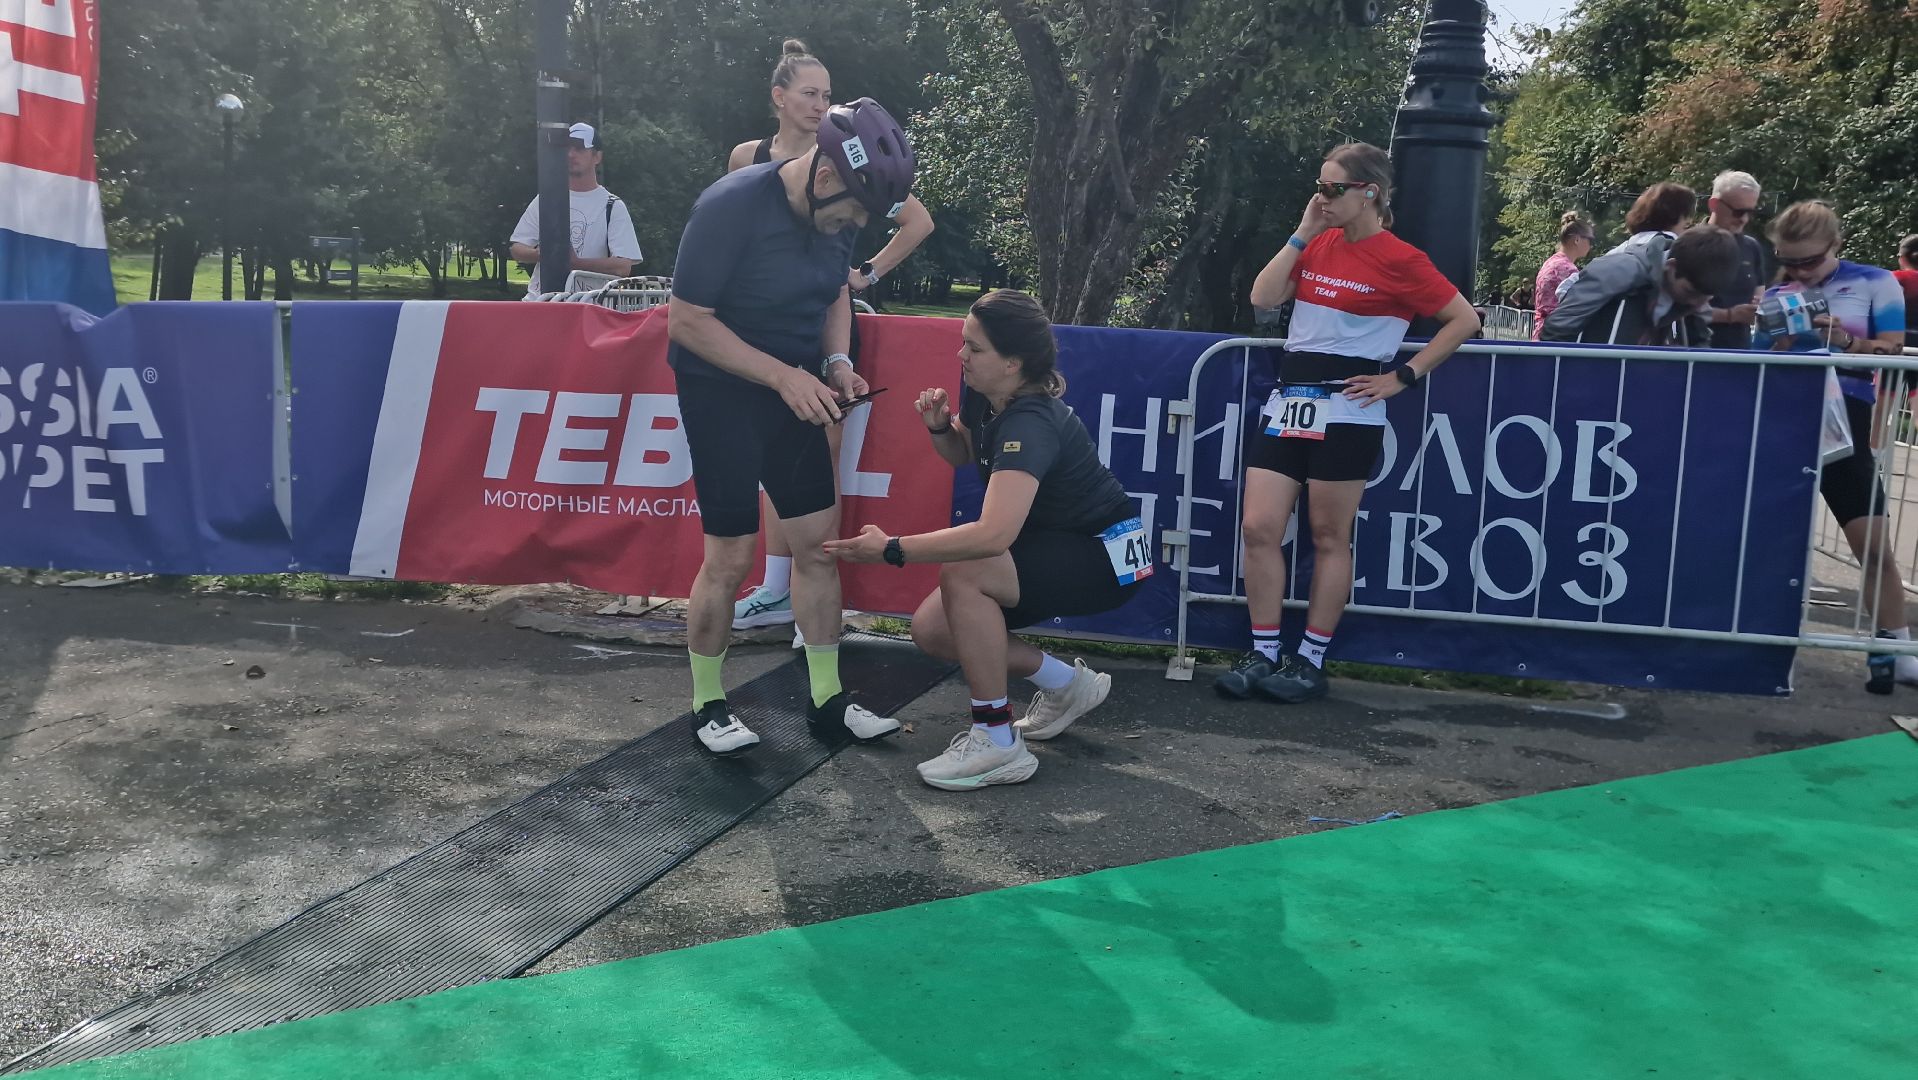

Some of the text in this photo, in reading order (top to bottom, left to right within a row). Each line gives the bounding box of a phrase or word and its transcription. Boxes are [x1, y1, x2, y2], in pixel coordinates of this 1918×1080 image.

[848, 142, 864, 164] 416
[1314, 286, 1338, 299] TEAM
[1280, 401, 1317, 429] 410
[484, 489, 702, 517] МОТОРНЫЕ МАСЛА
